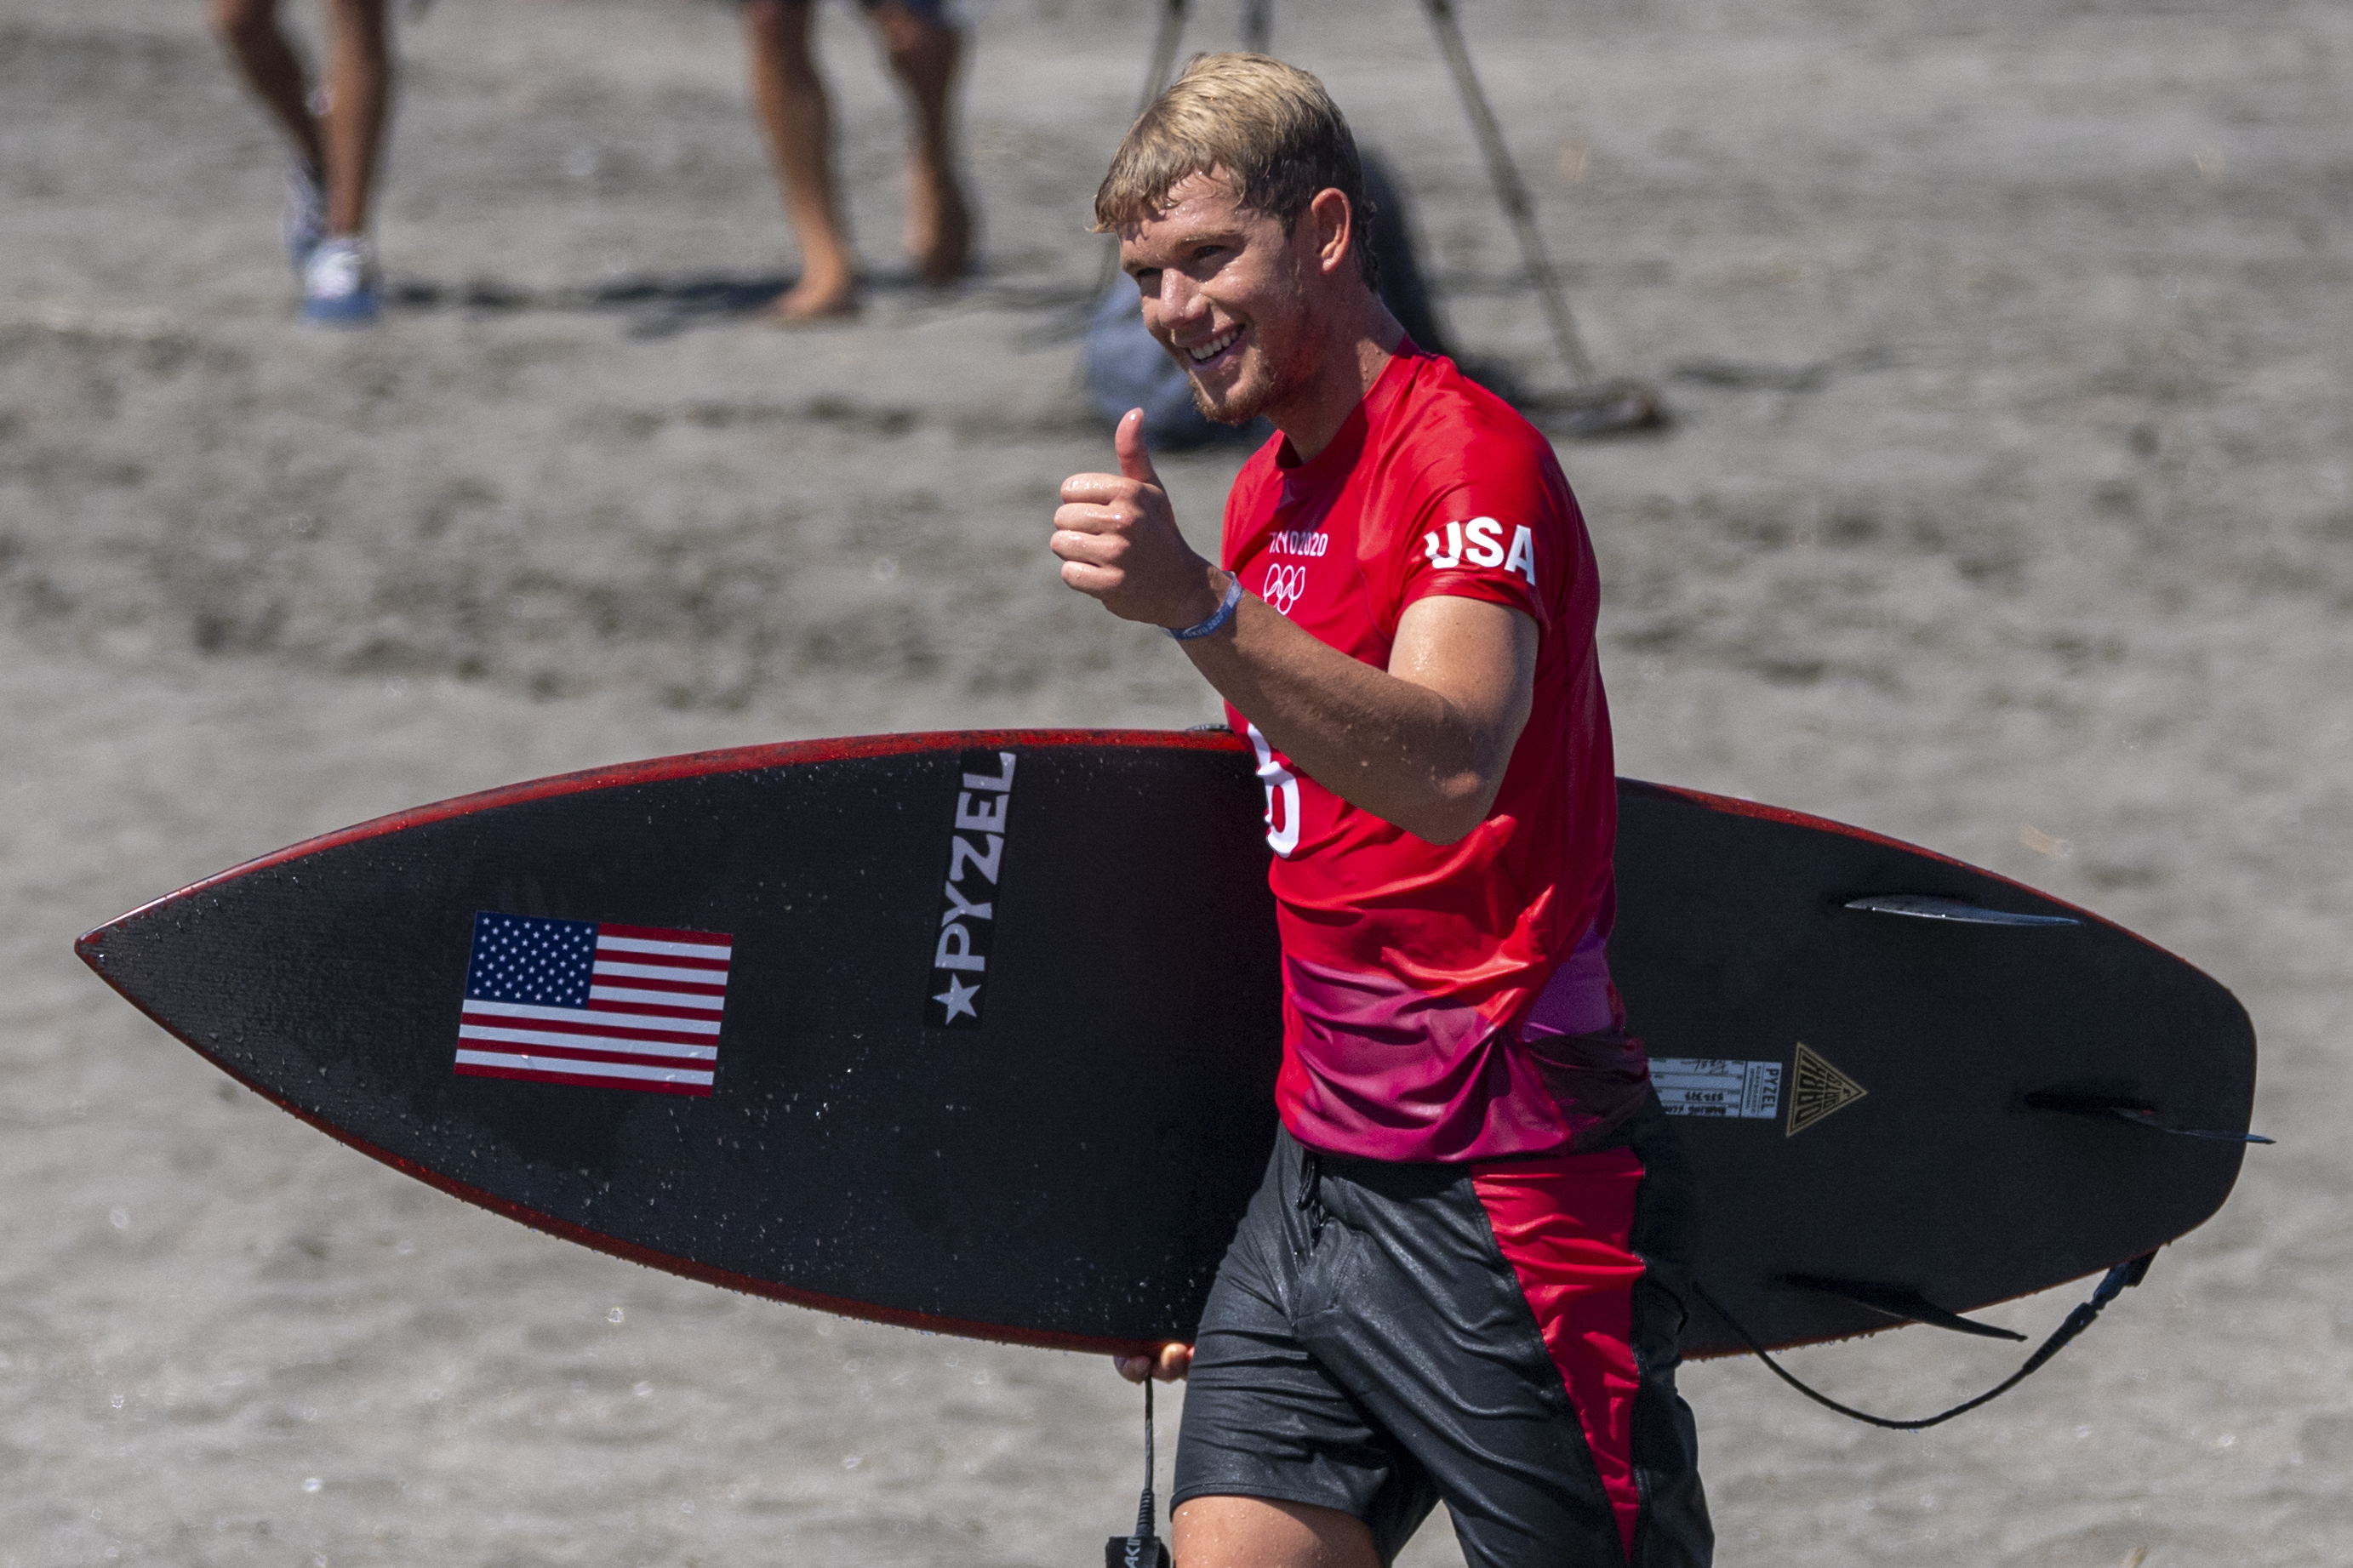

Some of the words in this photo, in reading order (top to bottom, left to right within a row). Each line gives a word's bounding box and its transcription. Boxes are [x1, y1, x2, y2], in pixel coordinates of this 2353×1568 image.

[1424, 516, 1536, 586] USA
[934, 751, 1017, 972] PYZEL
[1761, 1067, 1779, 1111] PYZEL
[1794, 1054, 1827, 1125] DARK
